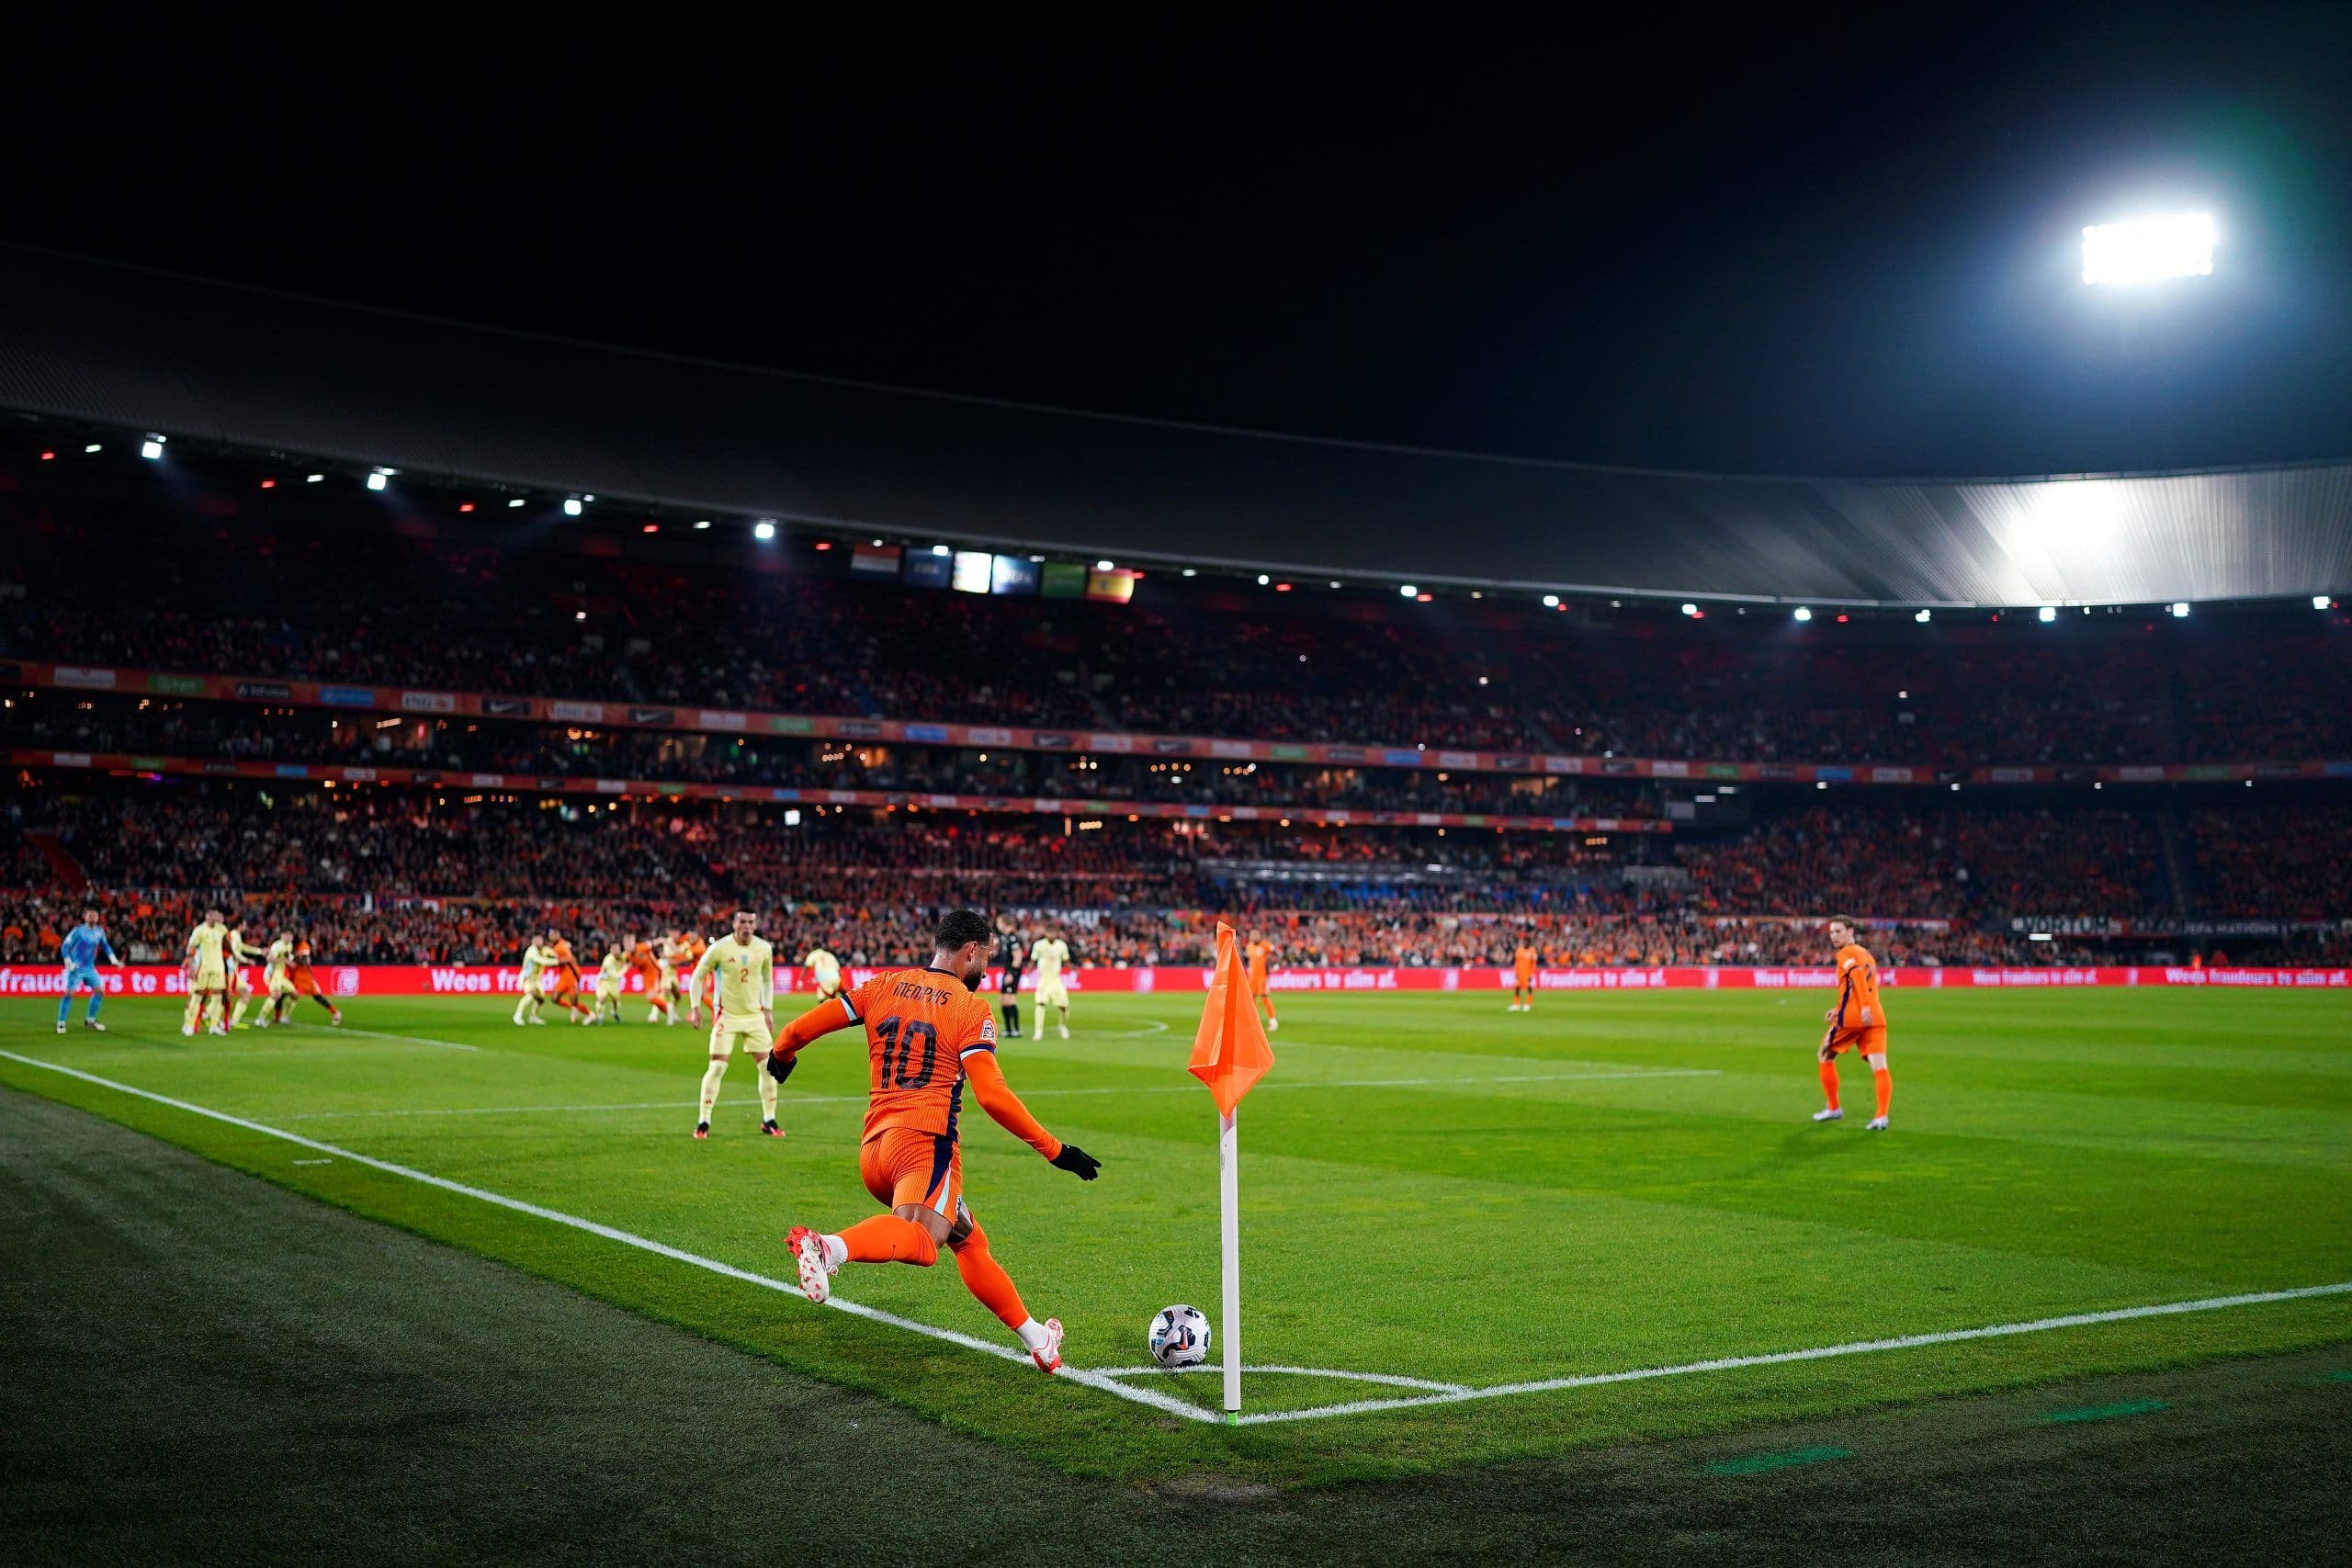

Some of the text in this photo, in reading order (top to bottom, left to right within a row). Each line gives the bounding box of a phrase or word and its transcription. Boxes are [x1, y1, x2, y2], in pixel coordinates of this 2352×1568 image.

[0, 969, 124, 993] fraudrs
[432, 969, 491, 992] Wees
[741, 967, 749, 983] 2
[893, 981, 953, 1006] MEMPHIS
[876, 1015, 937, 1089] 10
